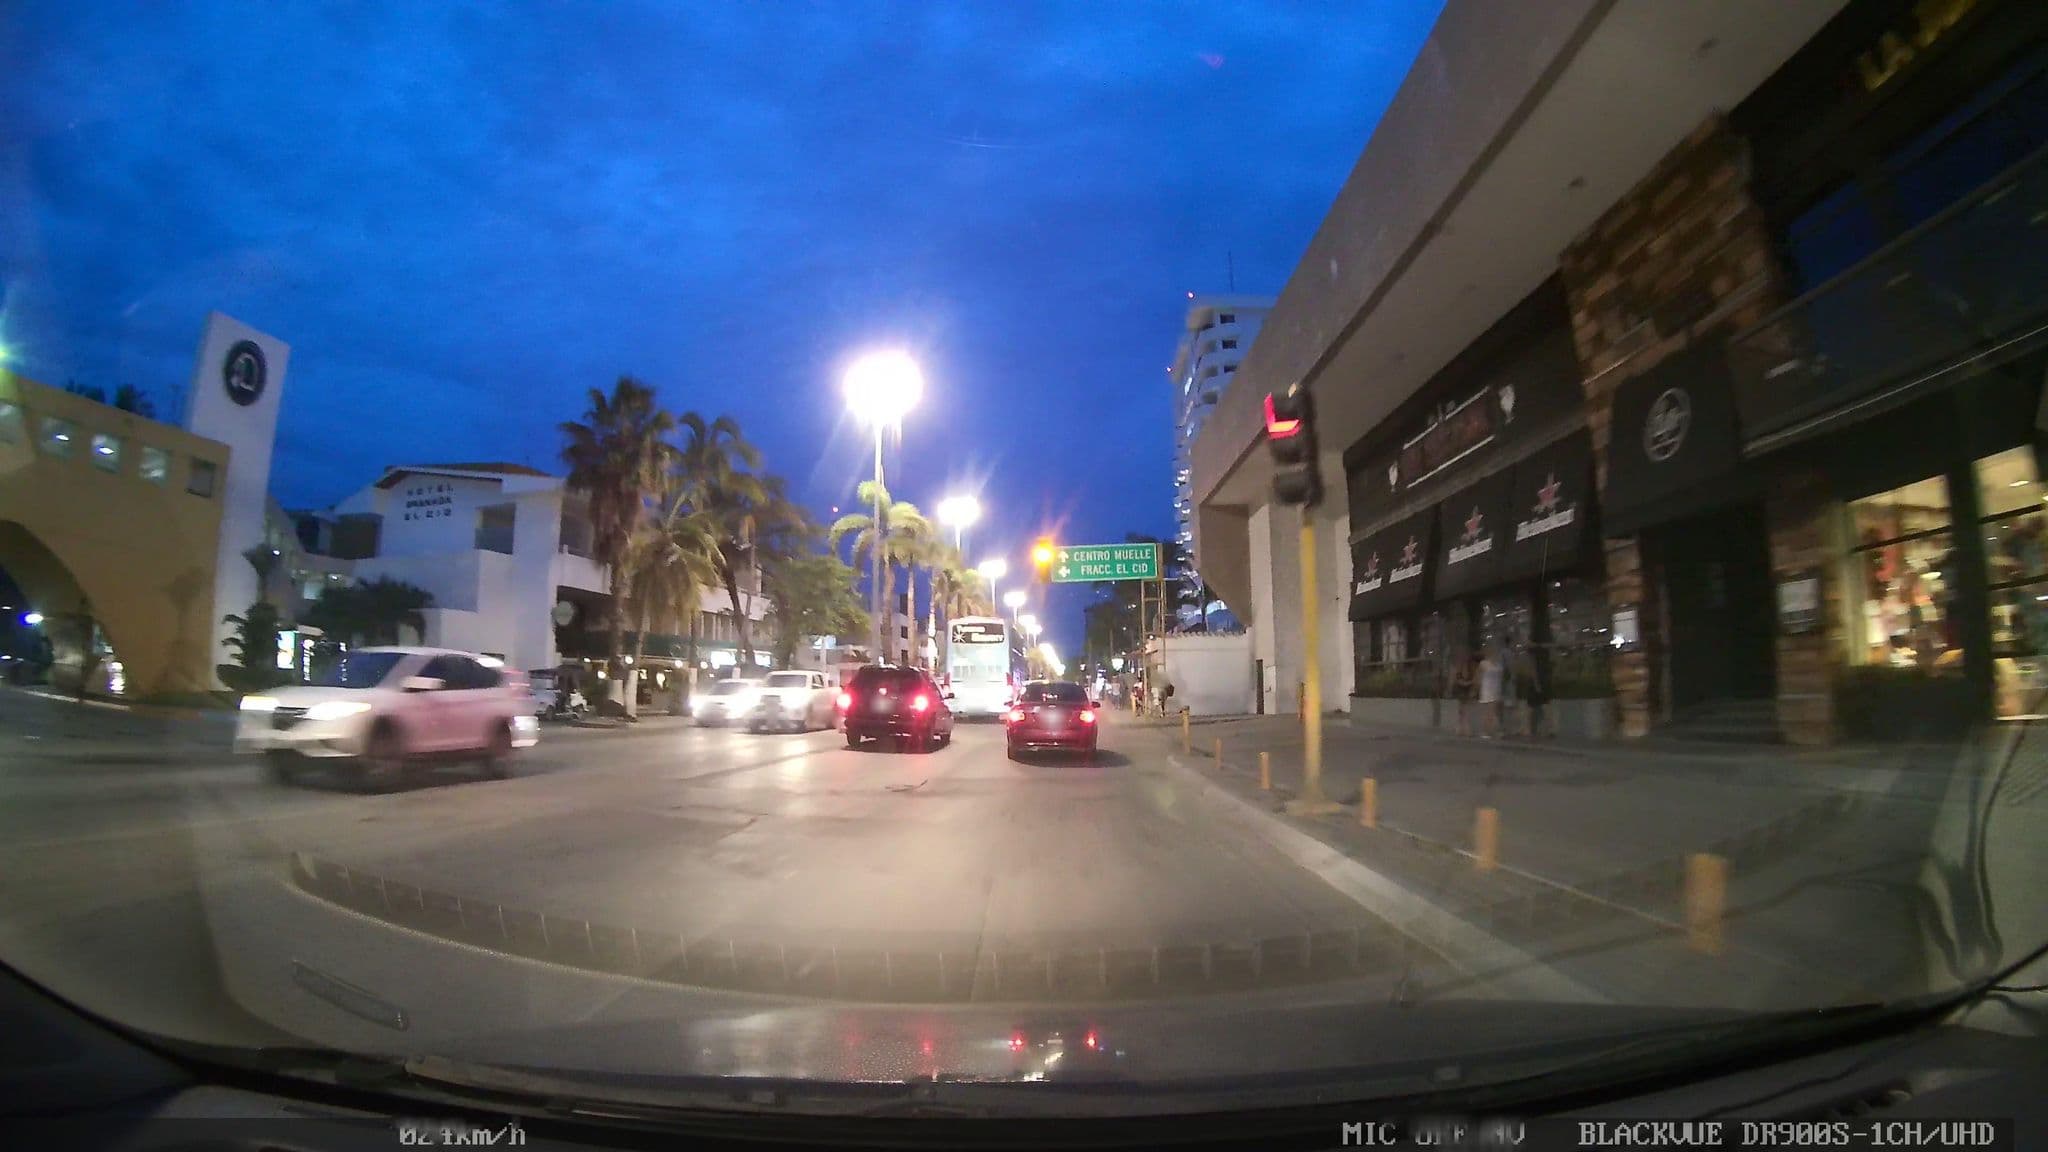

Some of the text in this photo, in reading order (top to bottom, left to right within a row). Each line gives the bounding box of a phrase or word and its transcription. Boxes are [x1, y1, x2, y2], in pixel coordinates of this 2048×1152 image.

[1073, 548, 1152, 562] CENTRO MUELLE
[1116, 563, 1130, 575] EL
[1132, 562, 1149, 574] CID
